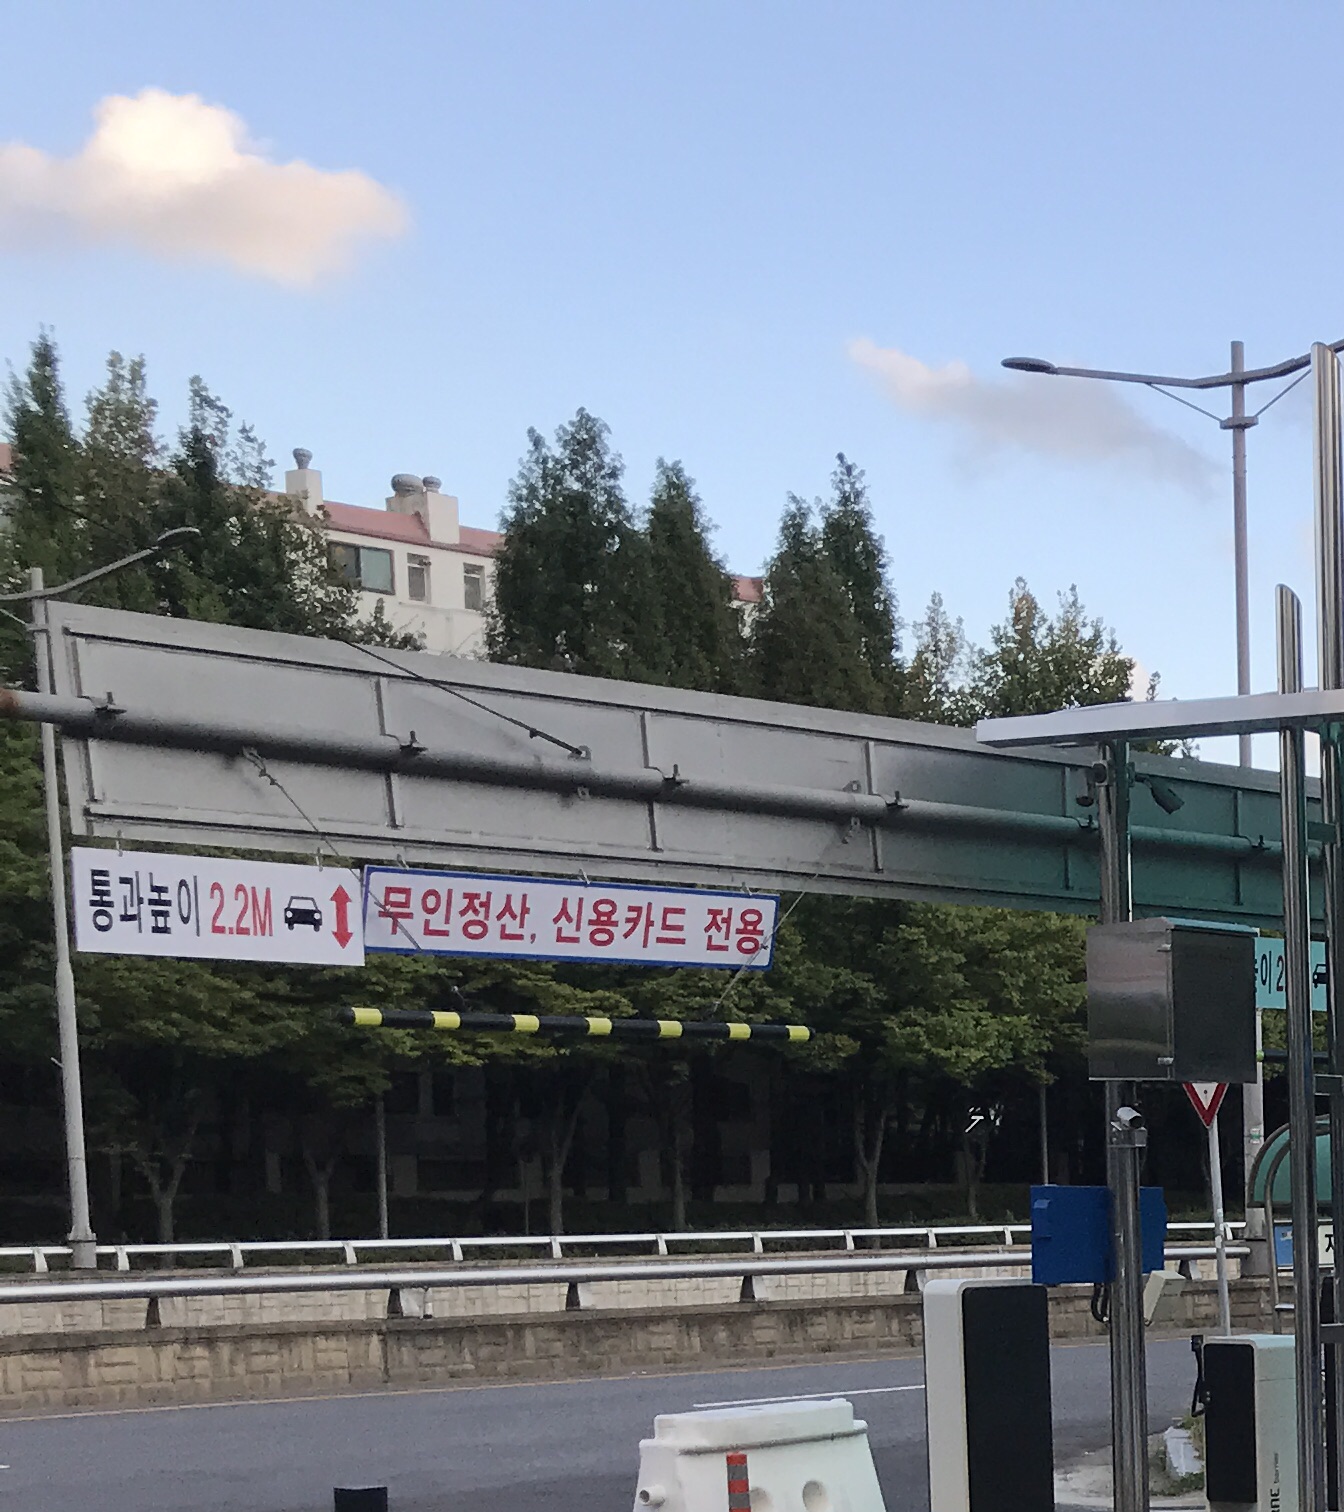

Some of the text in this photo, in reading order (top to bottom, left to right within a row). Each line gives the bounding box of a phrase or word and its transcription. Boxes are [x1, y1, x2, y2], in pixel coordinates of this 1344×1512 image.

[89, 868, 273, 937] 통과높이 2.2M
[378, 885, 765, 955] 무인정산, 신용카드 전용
